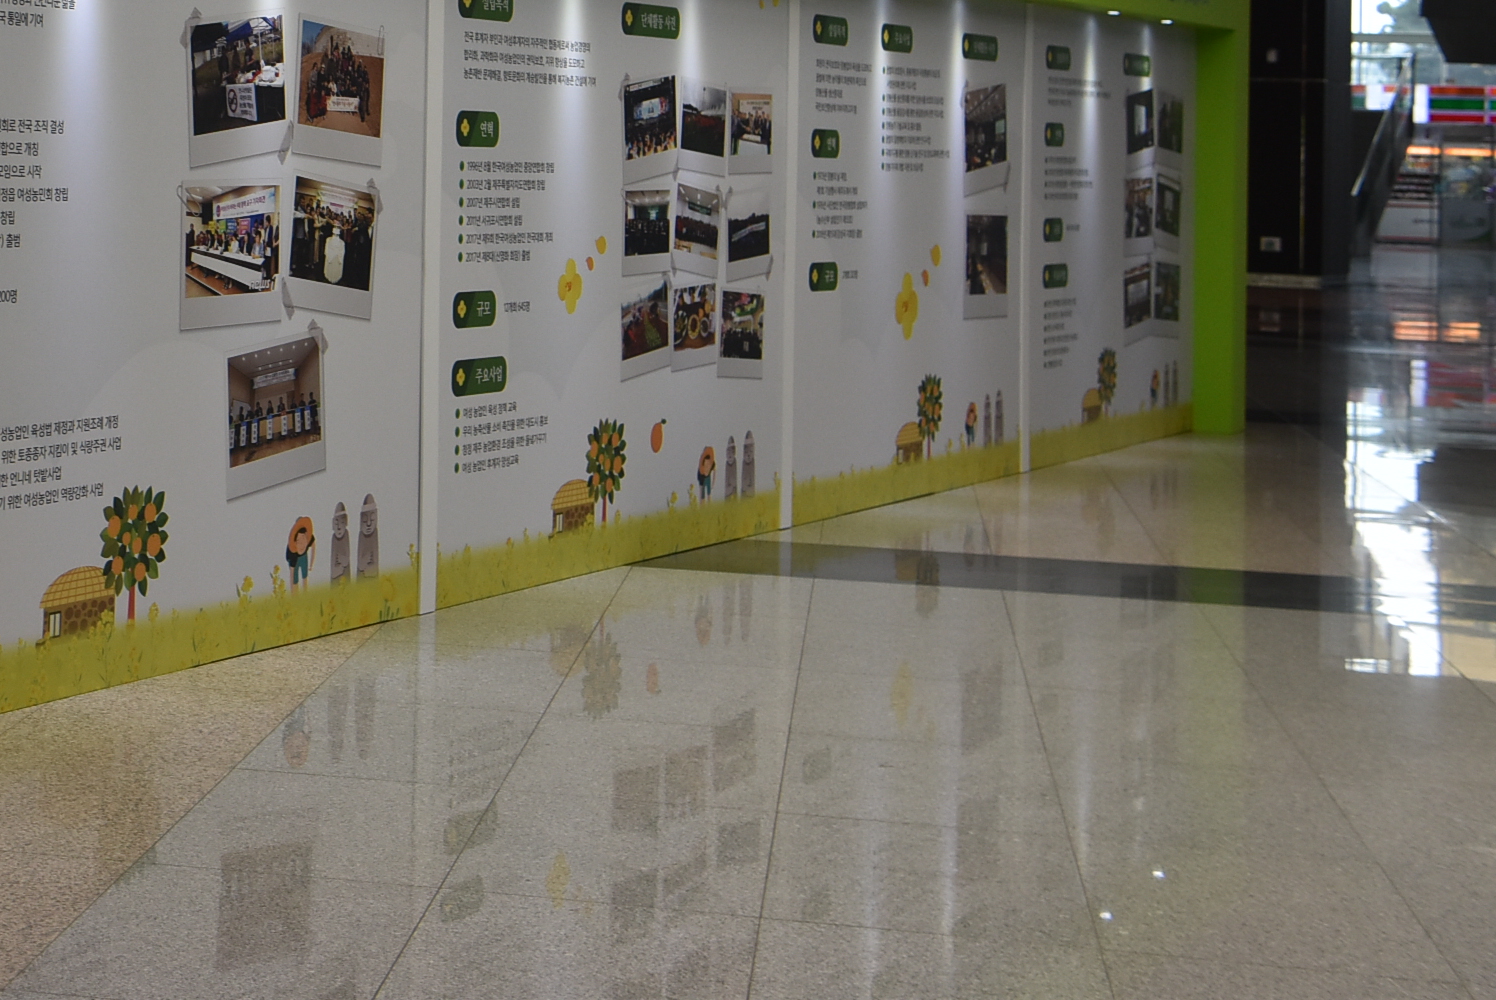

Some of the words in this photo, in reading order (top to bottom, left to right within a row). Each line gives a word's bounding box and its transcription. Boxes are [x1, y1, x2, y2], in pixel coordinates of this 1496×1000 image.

[17, 120, 33, 133] 전국
[33, 120, 49, 133] 조직
[49, 120, 65, 134] 결성
[23, 142, 39, 156] 개칭
[26, 165, 43, 178] 시작
[16, 188, 53, 202] 여성농민회
[53, 188, 69, 201] 창립
[0, 211, 16, 225] 창립
[5, 234, 21, 248] 출범
[476, 302, 491, 316] 규모
[475, 366, 503, 383] 주요사업
